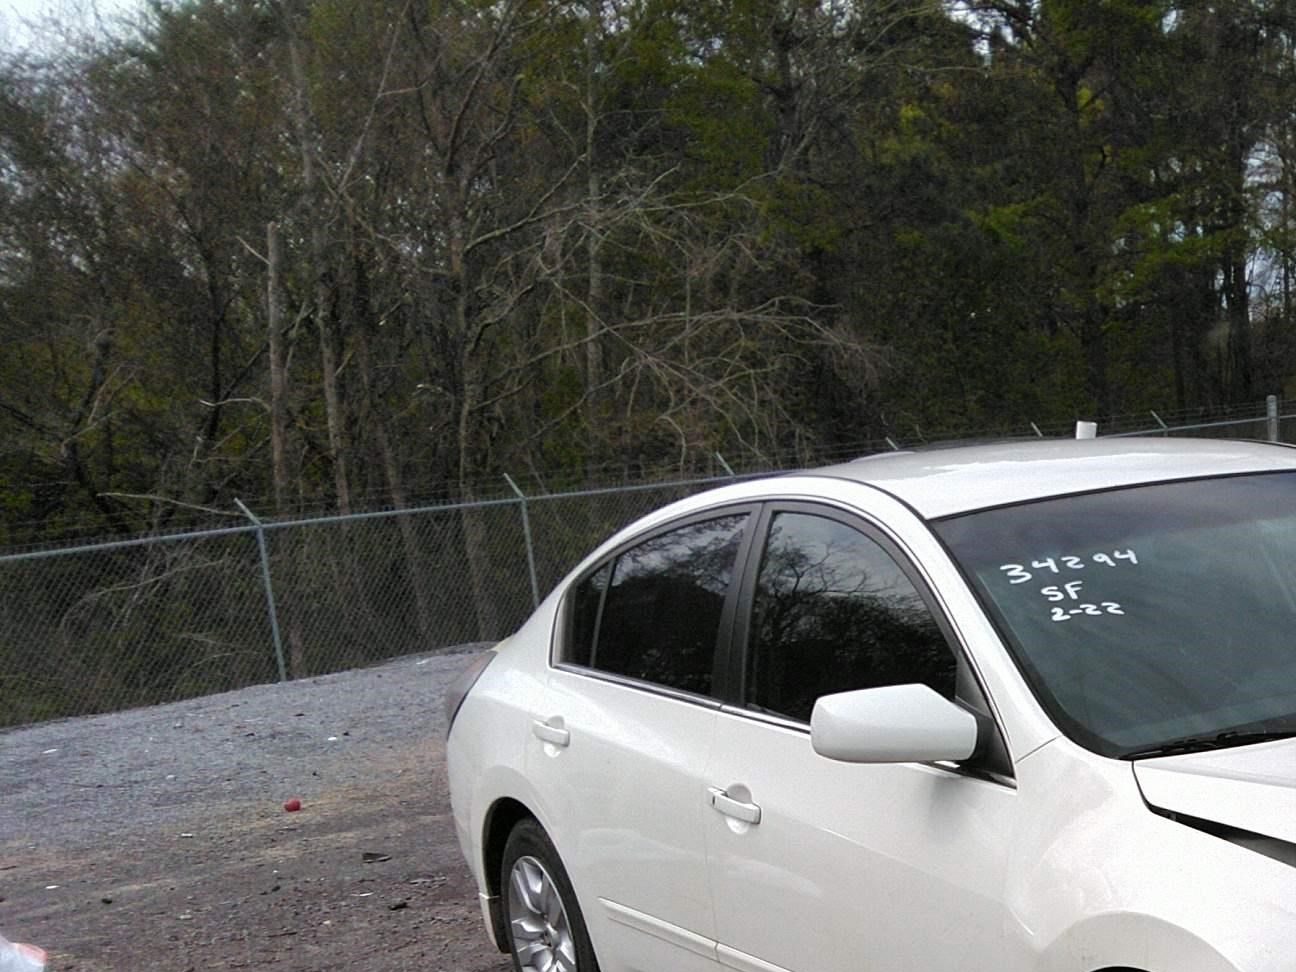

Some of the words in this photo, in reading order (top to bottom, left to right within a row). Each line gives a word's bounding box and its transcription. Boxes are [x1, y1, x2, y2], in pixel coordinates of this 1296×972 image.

[999, 549, 1139, 584] 34294
[1040, 580, 1084, 602] SF
[1050, 601, 1126, 622] 2-22
